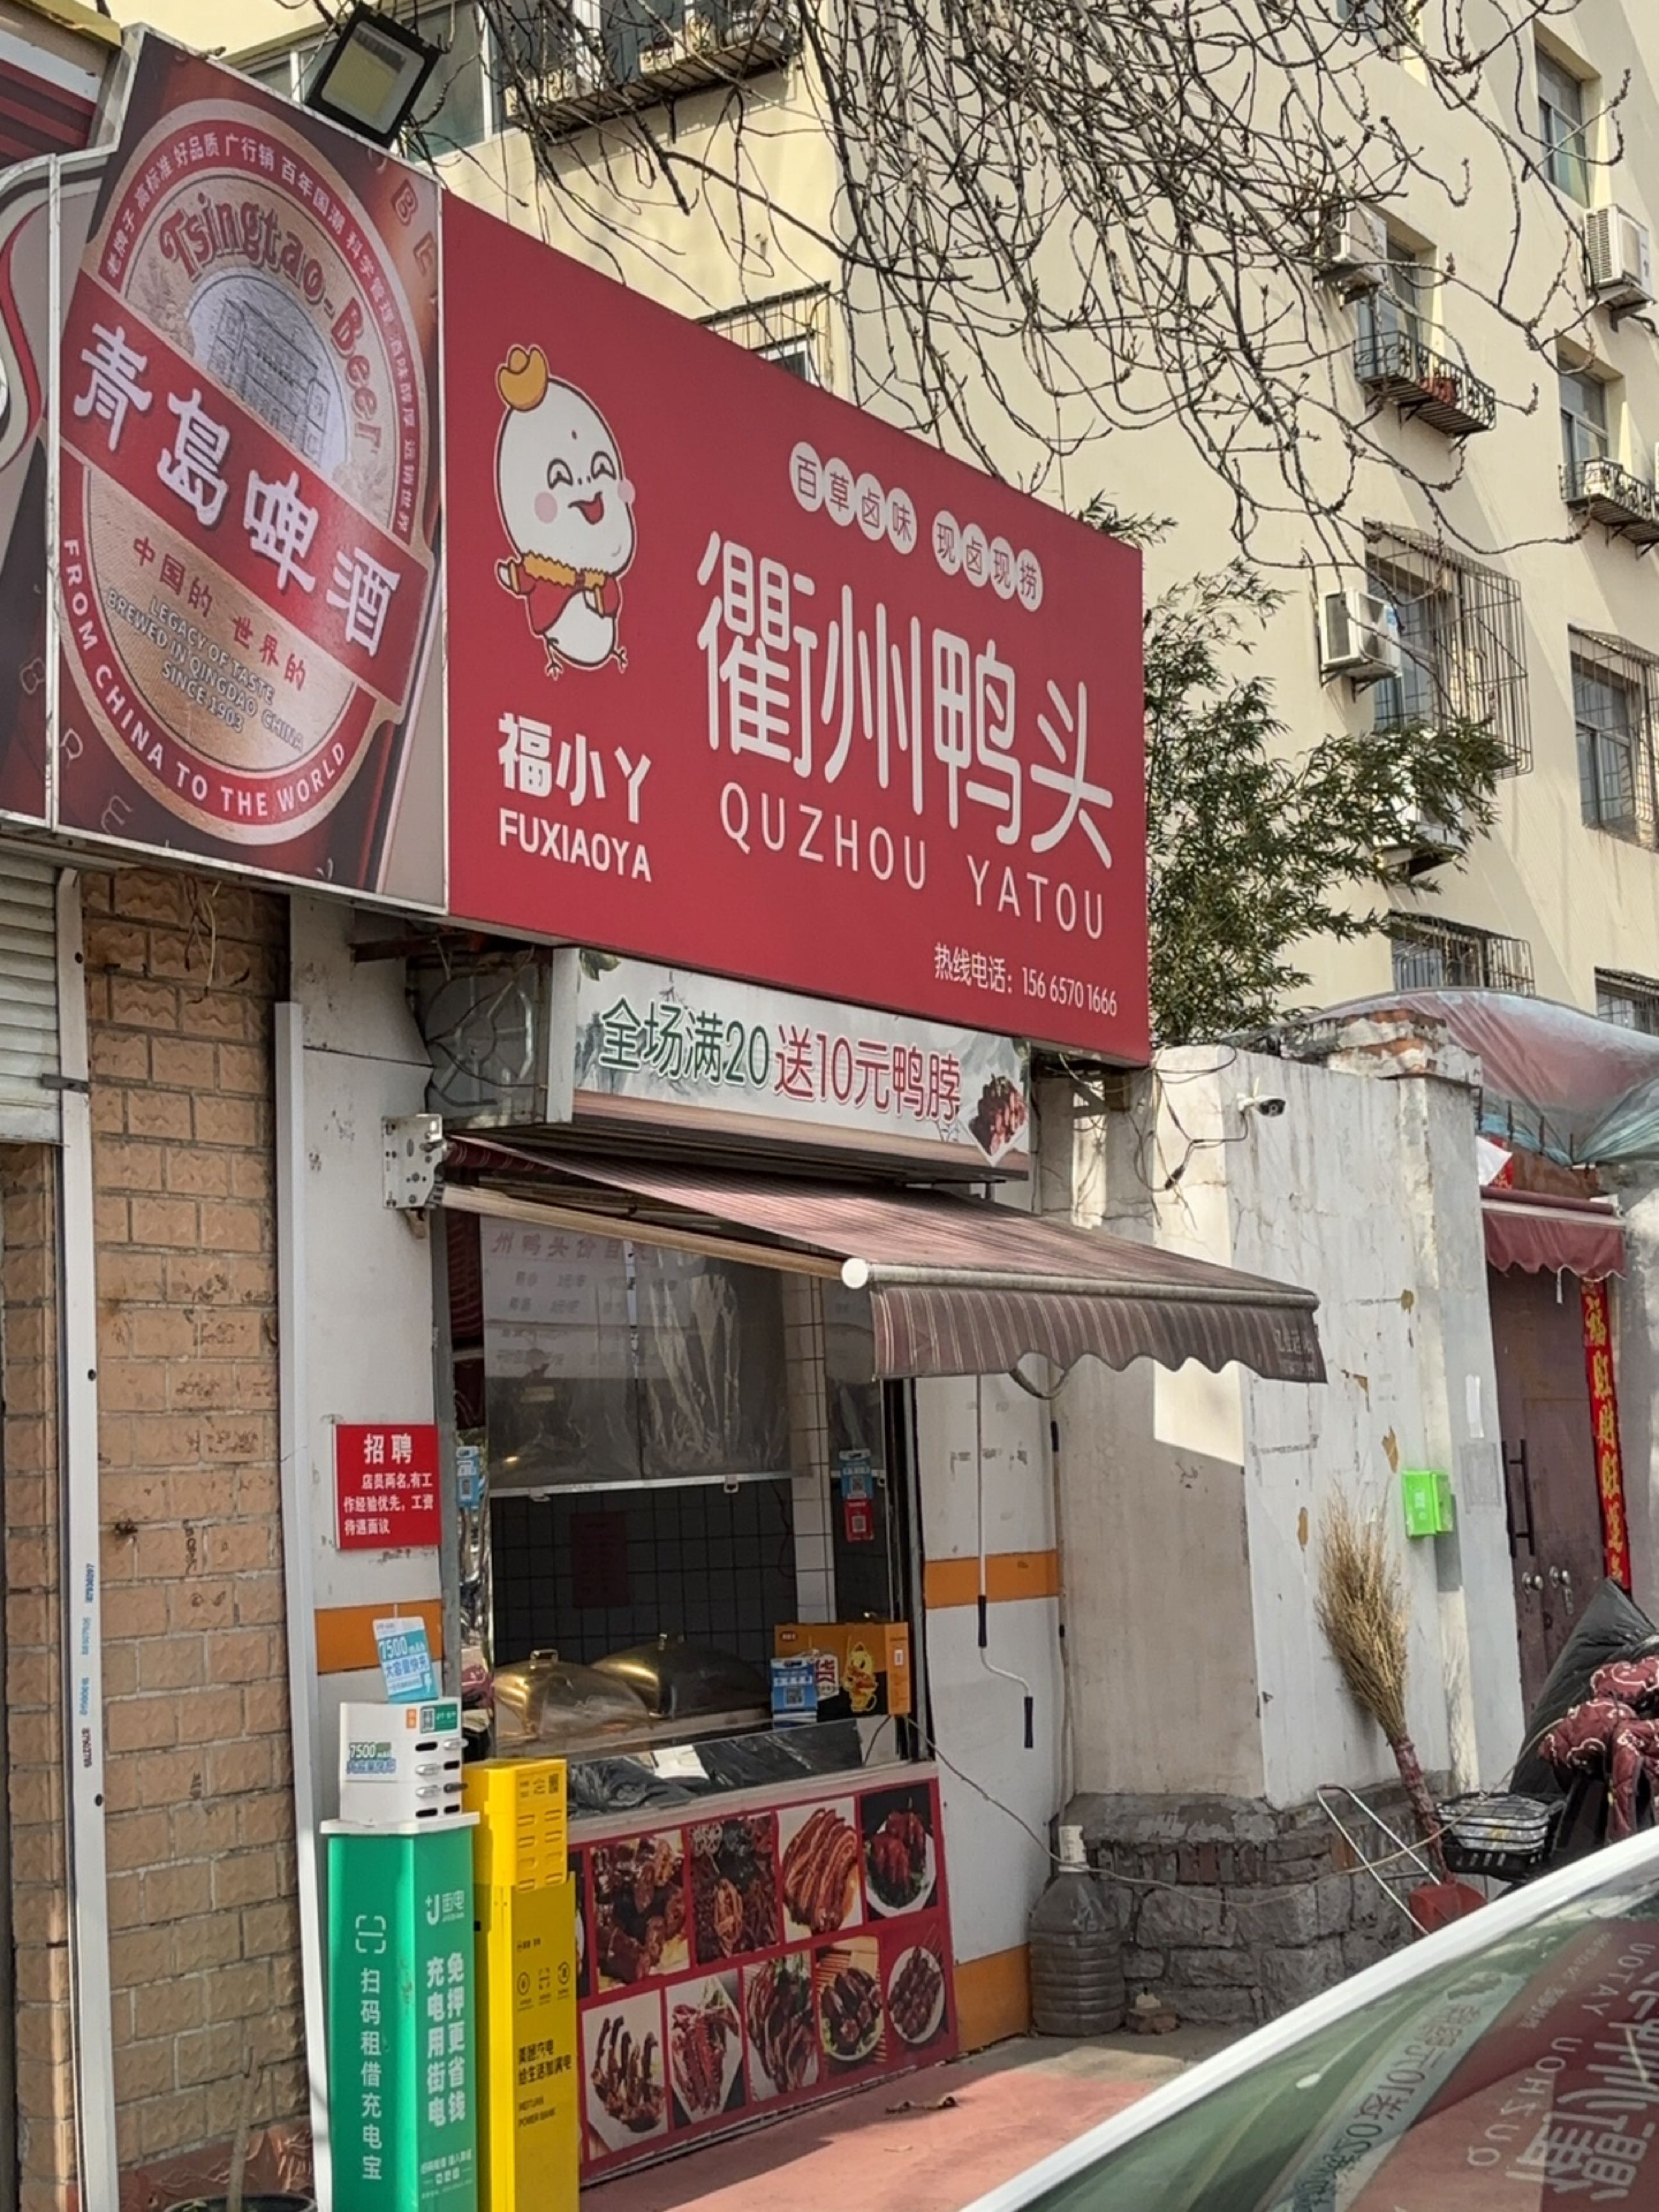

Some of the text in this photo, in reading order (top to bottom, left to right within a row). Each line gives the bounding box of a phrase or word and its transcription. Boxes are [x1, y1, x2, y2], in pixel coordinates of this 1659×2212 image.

[173, 132, 220, 168] 好品质
[225, 133, 274, 171] 广行销
[795, 452, 913, 545] 百草卤味
[106, 588, 168, 649] BREWED
[170, 642, 186, 664] IN
[189, 657, 258, 717] QINGDAO
[134, 536, 306, 690] 中国的 世界的
[150, 596, 276, 705] LEGACY OF TASTE
[64, 539, 99, 652] FROM
[95, 665, 164, 771] CHINA
[176, 762, 208, 800] TO
[221, 785, 268, 817] THE
[276, 741, 344, 812] WORLD
[161, 660, 244, 733] SINCE 1903
[697, 530, 1114, 869] 衢州鸭头
[499, 712, 652, 824] 福小丫
[499, 807, 652, 883] FUXIAOYA
[720, 782, 1103, 940] QUZHOU YATOU
[364, 1433, 412, 1464] 招聘
[360, 1968, 382, 2180] 扫码租借充电宝
[426, 1957, 445, 2128] 充电用街电
[447, 1952, 466, 2122] 免押更省钱
